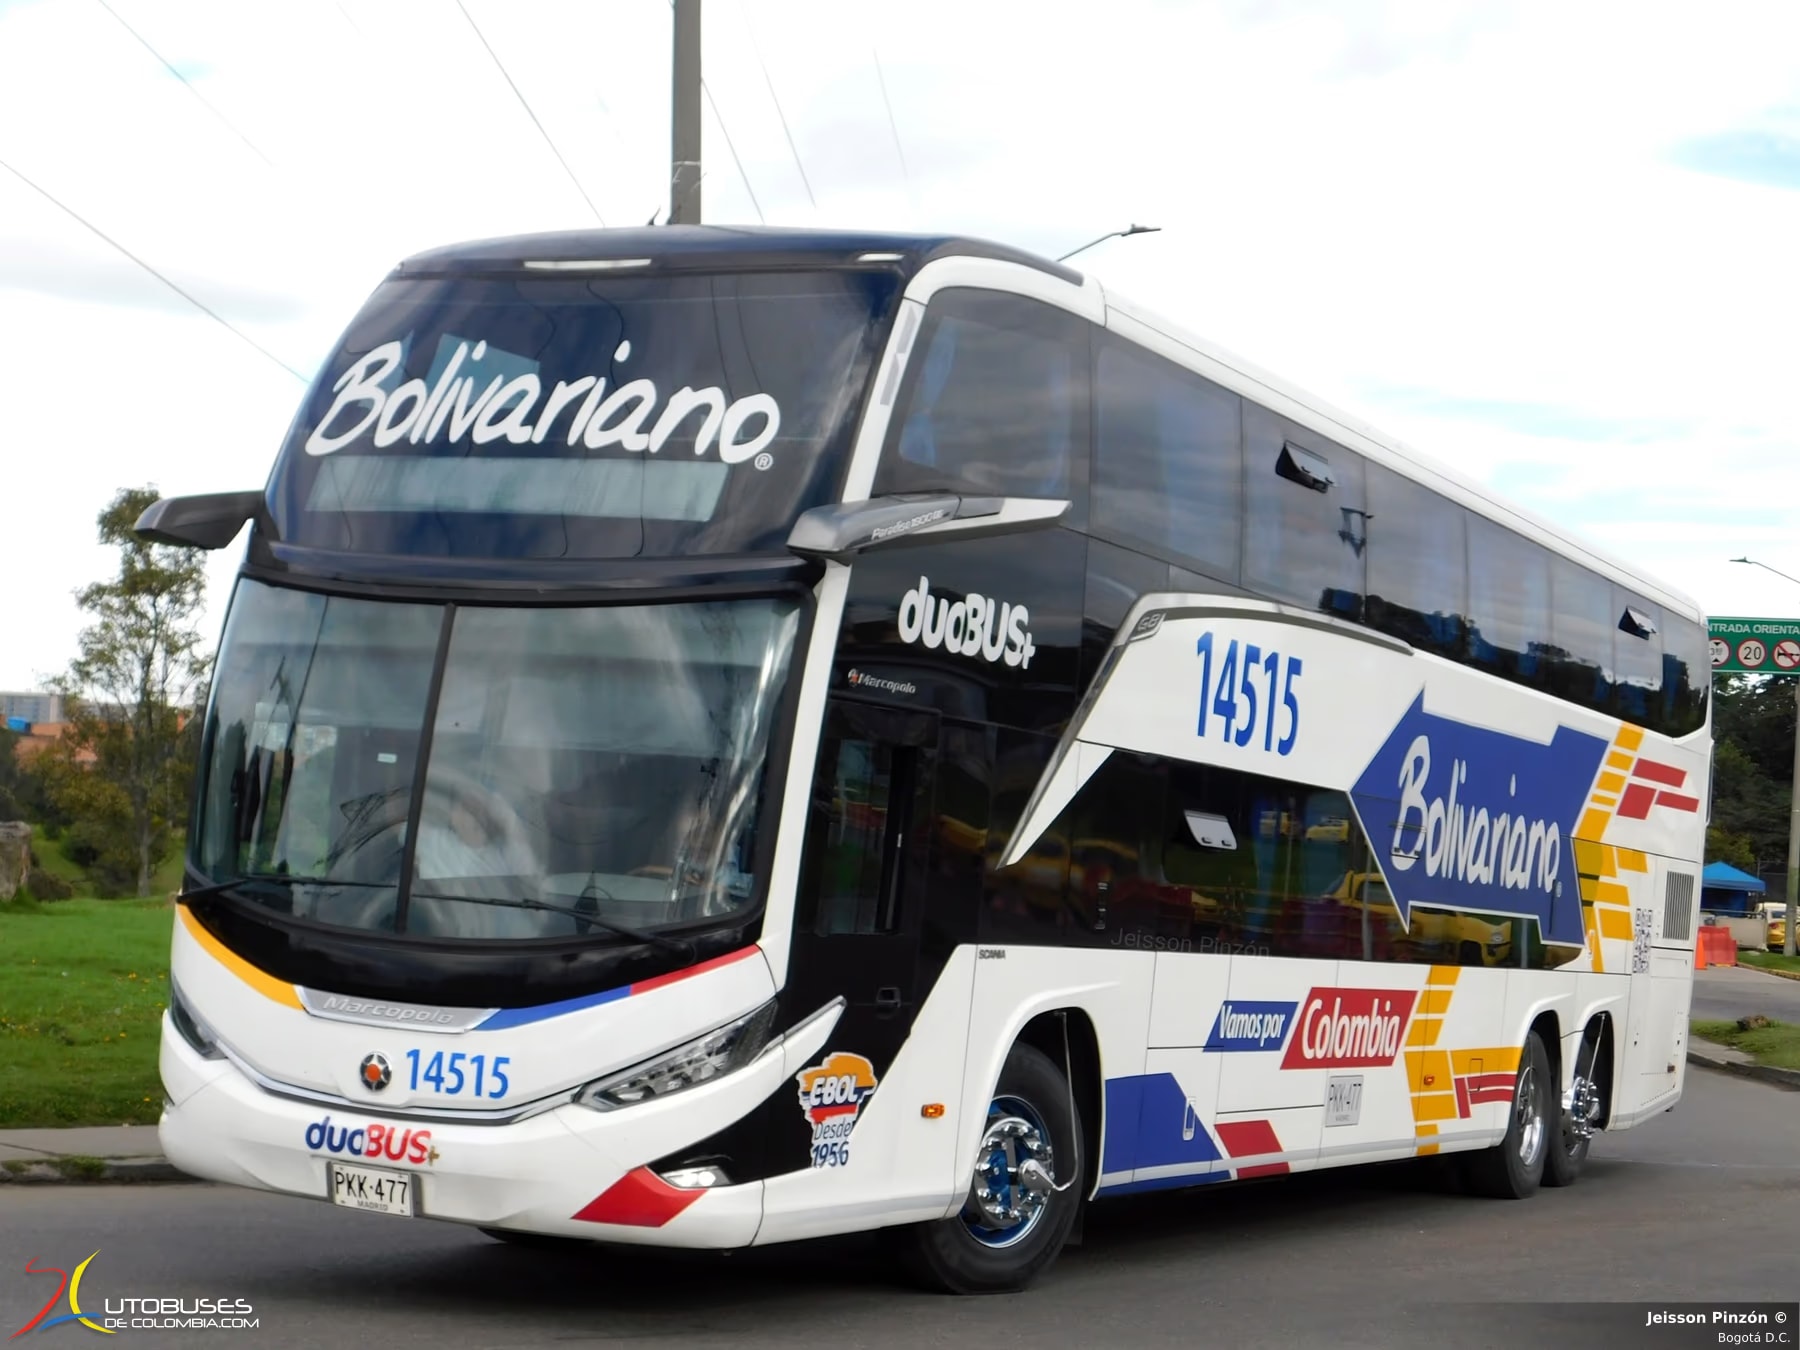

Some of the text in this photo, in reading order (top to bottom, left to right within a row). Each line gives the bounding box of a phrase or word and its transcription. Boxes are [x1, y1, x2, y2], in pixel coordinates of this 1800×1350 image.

[304, 339, 781, 464] Bolivariano
[1707, 623, 1751, 633] NTRADA
[1743, 646, 1762, 660] 20
[858, 672, 917, 694] Marcopolo
[1196, 631, 1303, 757] 14515
[1391, 735, 1561, 893] Bolivariano
[322, 996, 454, 1024] Marcopolo
[1219, 1005, 1286, 1047] Vamos por
[1302, 997, 1401, 1060] Colombia
[405, 1048, 511, 1100] 14515
[813, 1119, 851, 1141] Desde
[812, 1141, 850, 1167] 1956
[357, 1200, 389, 1212] MADRID
